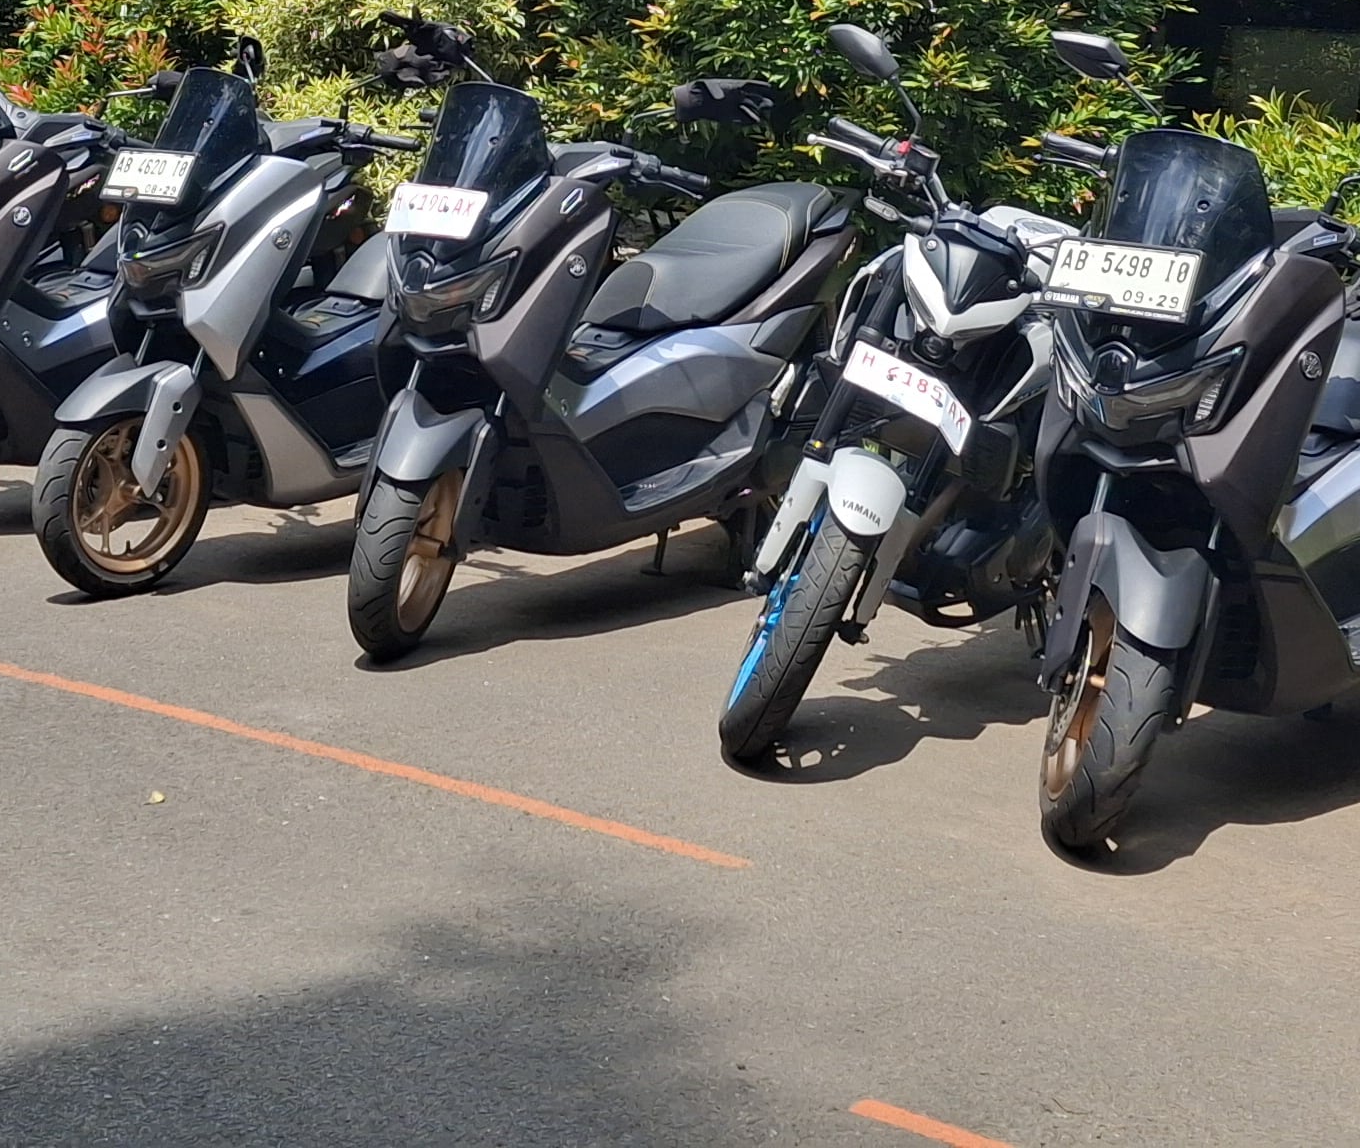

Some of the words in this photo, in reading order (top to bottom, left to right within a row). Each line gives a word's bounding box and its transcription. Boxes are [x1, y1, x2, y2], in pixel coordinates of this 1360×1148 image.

[115, 156, 133, 173] AB
[138, 158, 167, 176] 4620
[394, 192, 403, 211] H
[453, 198, 475, 217] AX
[1060, 249, 1090, 271] AB
[1101, 252, 1154, 278] 5498
[862, 351, 875, 367] H
[948, 401, 966, 429] AX
[842, 499, 881, 528] YAMAHA
